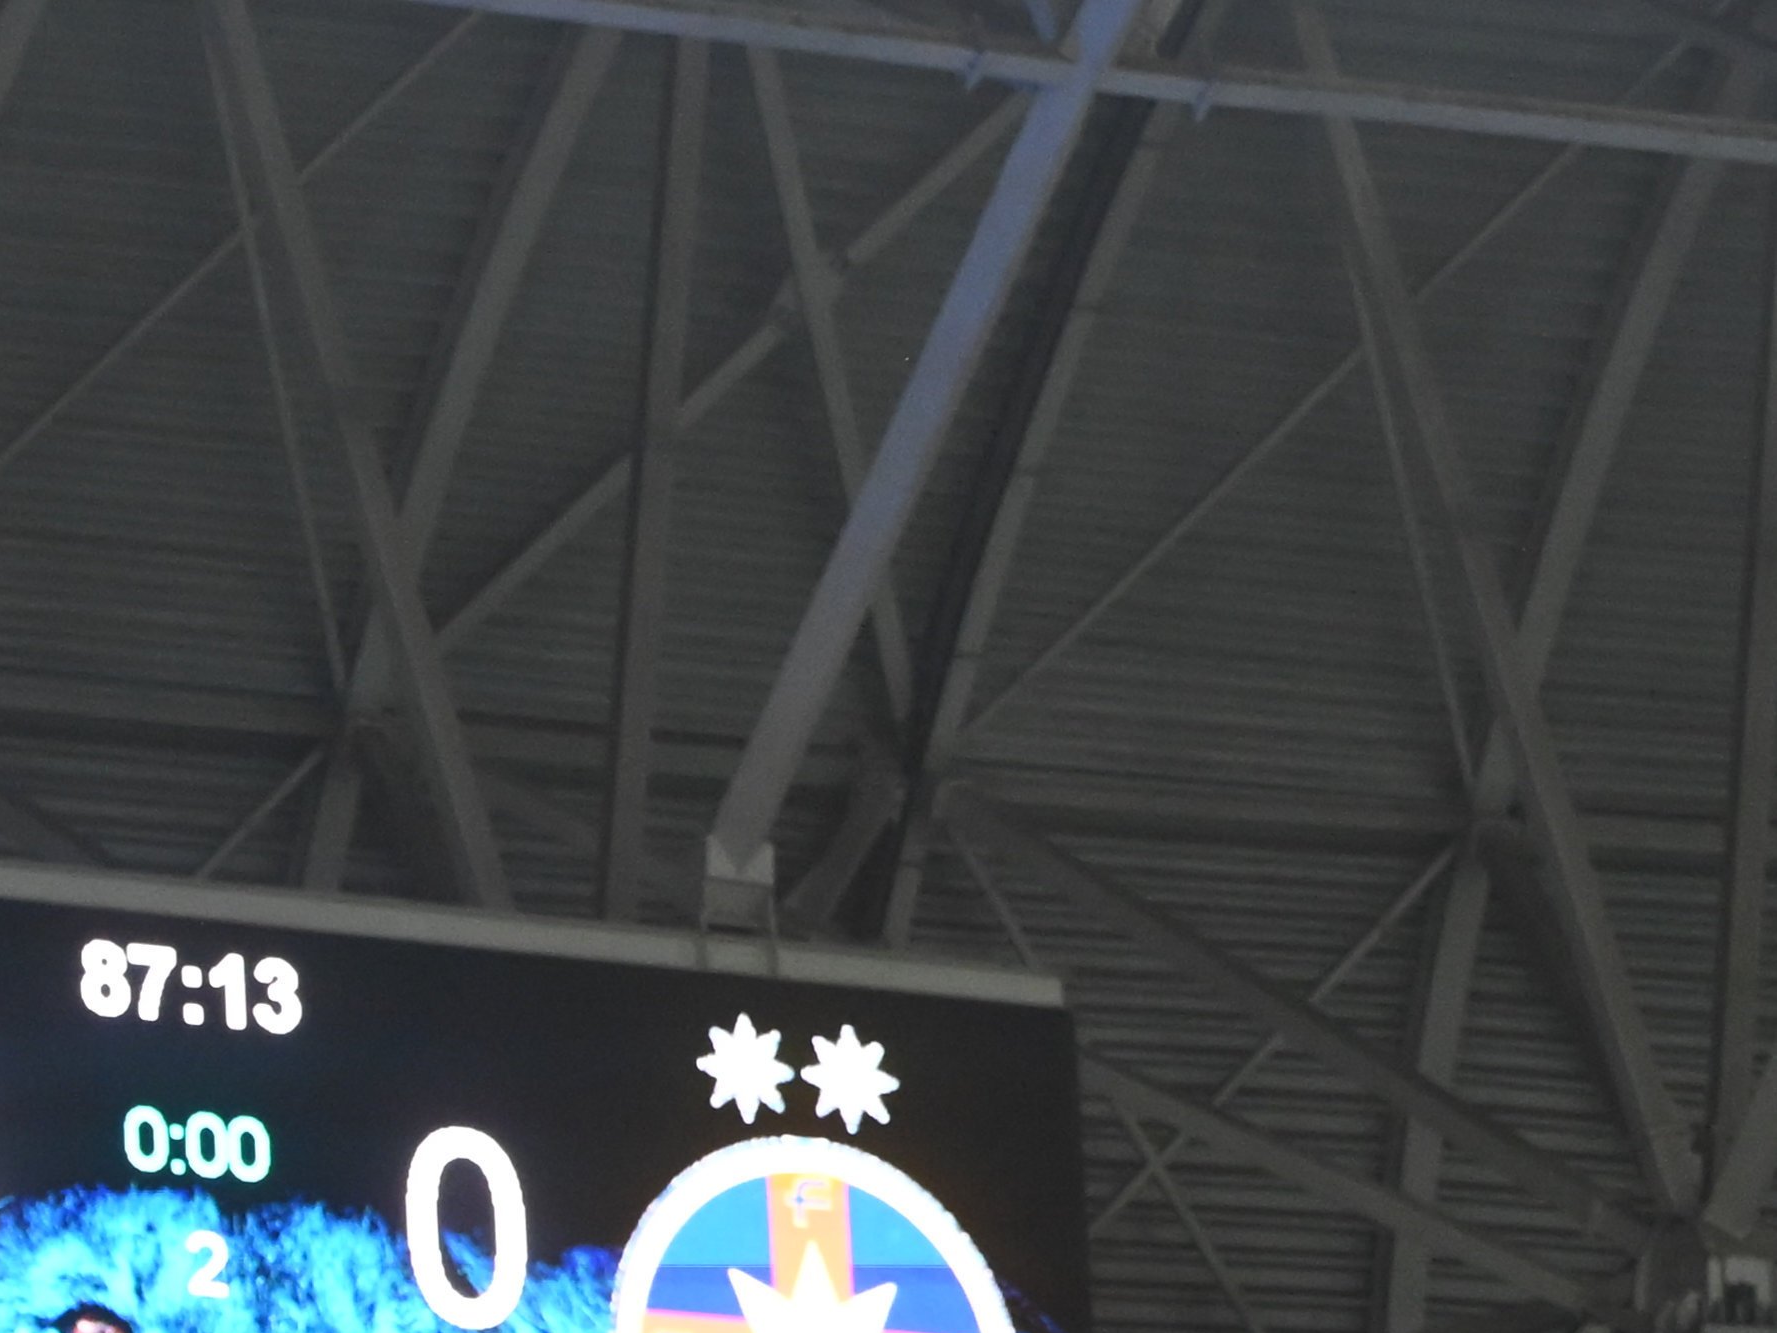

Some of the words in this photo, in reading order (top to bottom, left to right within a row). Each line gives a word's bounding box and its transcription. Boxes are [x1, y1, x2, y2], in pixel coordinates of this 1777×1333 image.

[80, 938, 303, 1035] 87:13
[123, 1105, 271, 1183] 0:00
[184, 1229, 230, 1299] 2
[405, 1126, 528, 1331] 0
